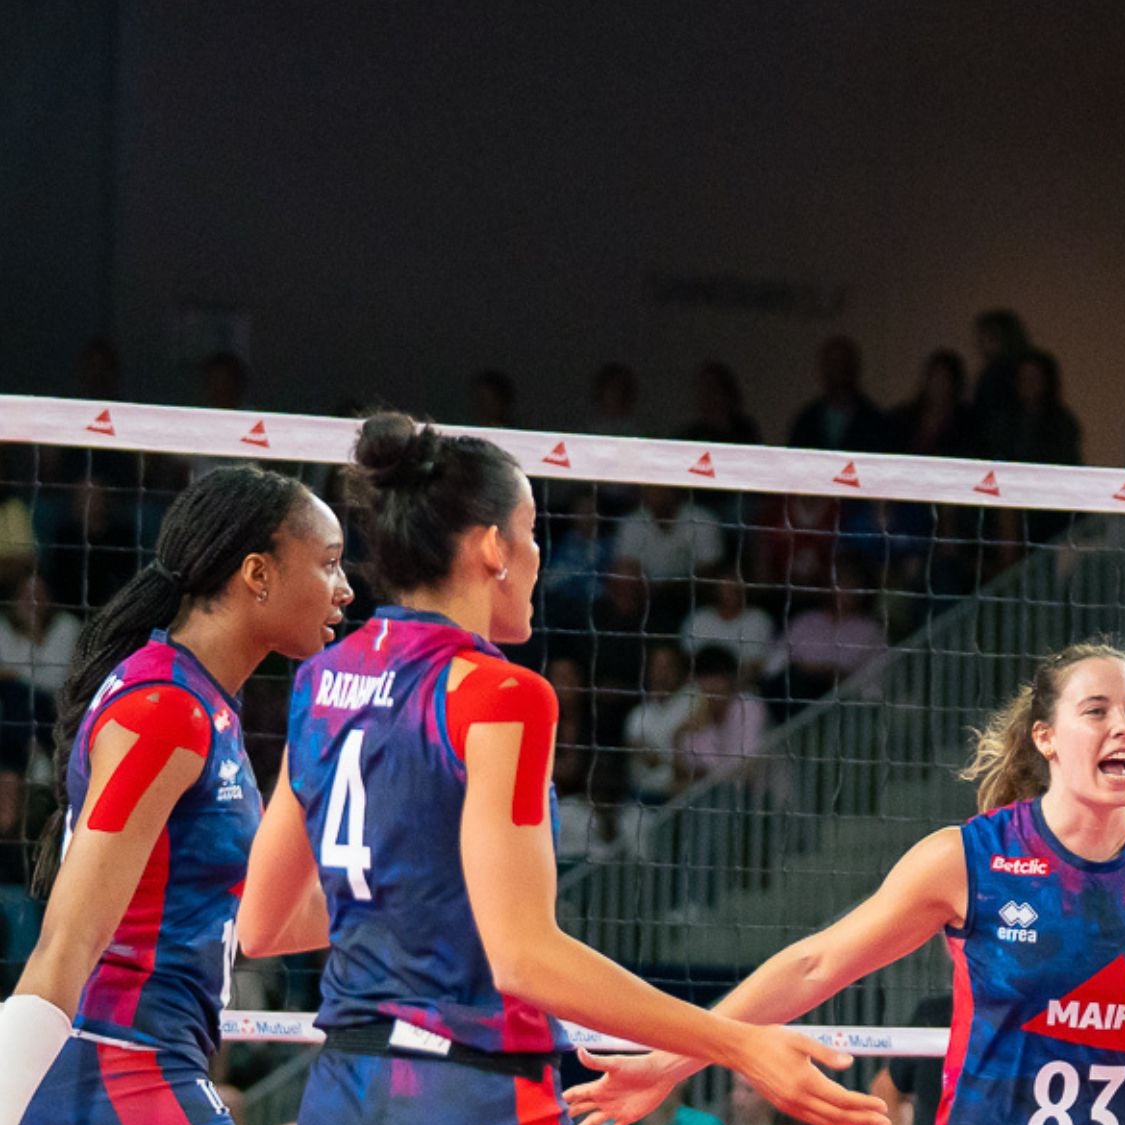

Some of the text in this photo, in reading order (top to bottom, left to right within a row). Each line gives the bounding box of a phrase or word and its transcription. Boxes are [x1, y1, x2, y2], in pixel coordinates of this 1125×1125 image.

[320, 728, 372, 901] 4
[992, 855, 1049, 875] Betclic
[220, 918, 239, 1008] 1
[256, 1020, 303, 1034] Mutuel
[569, 1029, 602, 1043] utuel
[848, 1034, 893, 1048] Mutuel
